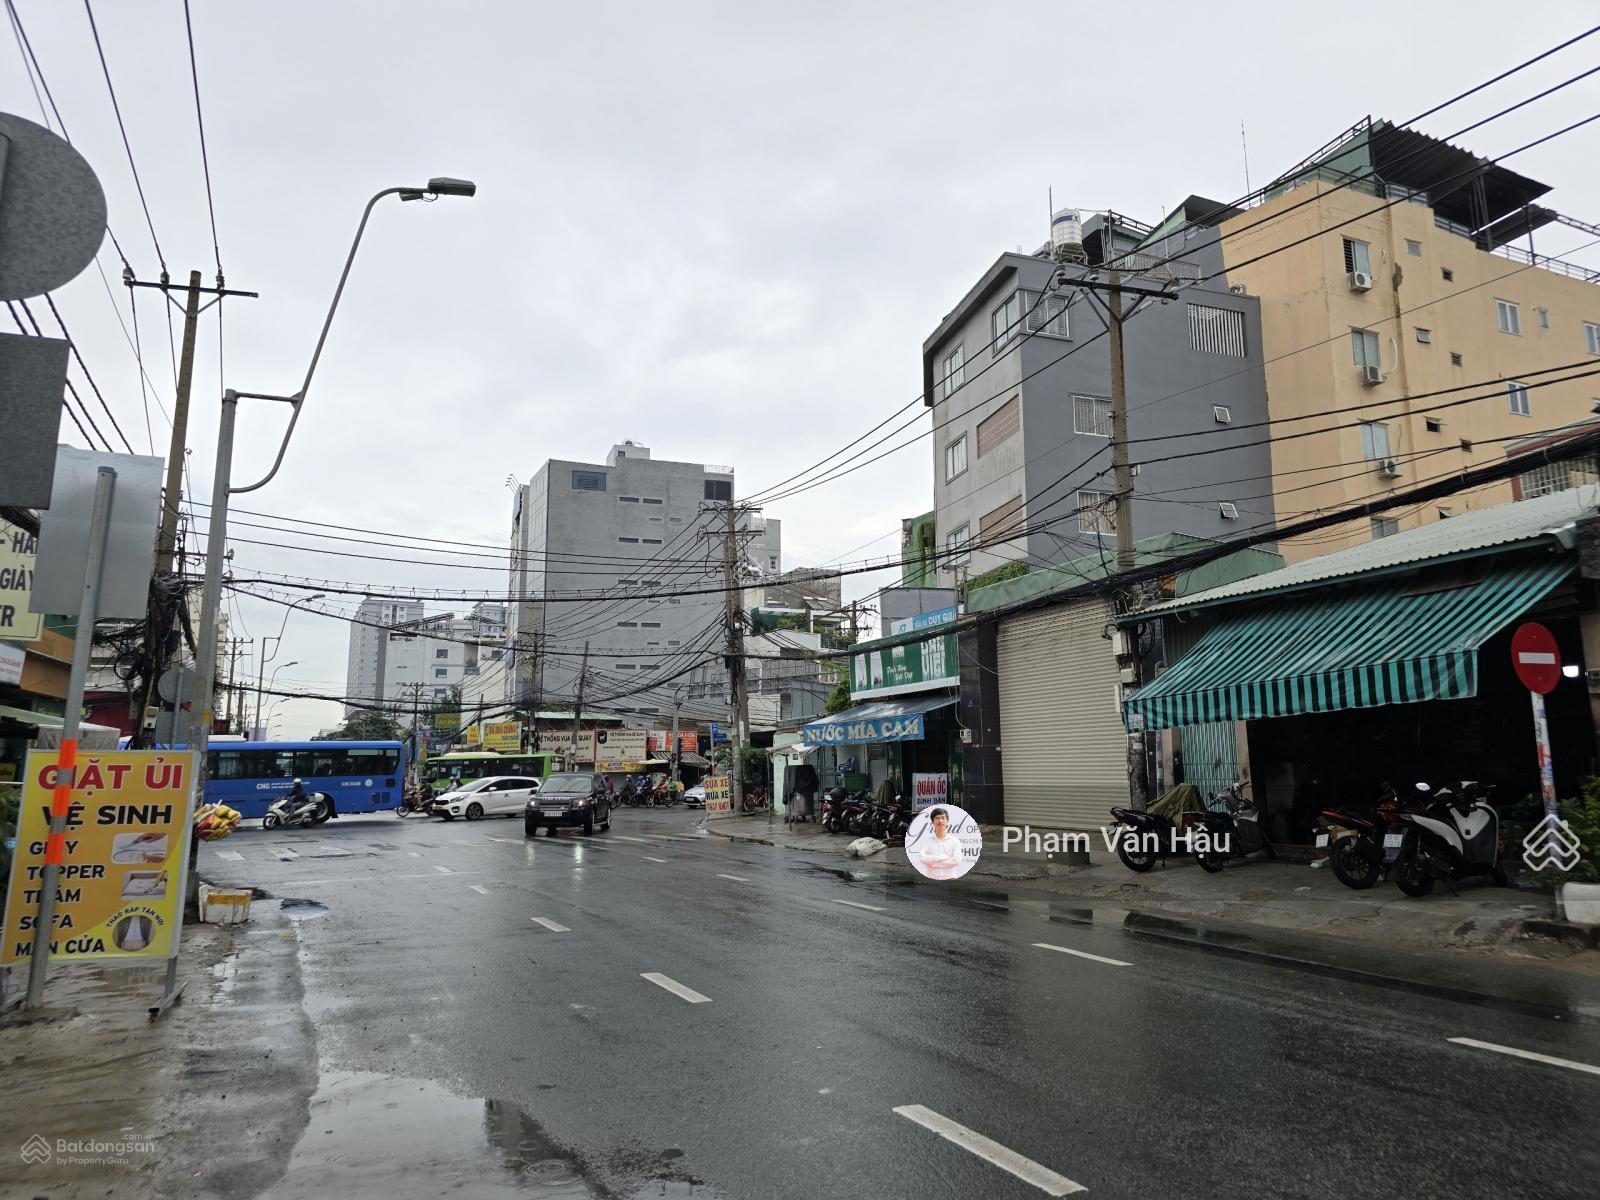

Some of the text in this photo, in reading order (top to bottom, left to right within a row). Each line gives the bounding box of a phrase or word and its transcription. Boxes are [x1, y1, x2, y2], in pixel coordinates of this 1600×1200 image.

[12, 531, 38, 554] HA
[0, 604, 15, 627] R
[806, 719, 920, 742] NƯỚC MÍA CAM
[145, 757, 183, 790] ỦI
[720, 778, 728, 788] XE
[720, 790, 728, 798] XE
[916, 774, 946, 796] QUÁN ỐC
[96, 804, 172, 825] SINH
[30, 840, 78, 855] GIY
[26, 864, 104, 880] TPER
[16, 934, 104, 957] MN CỬA
